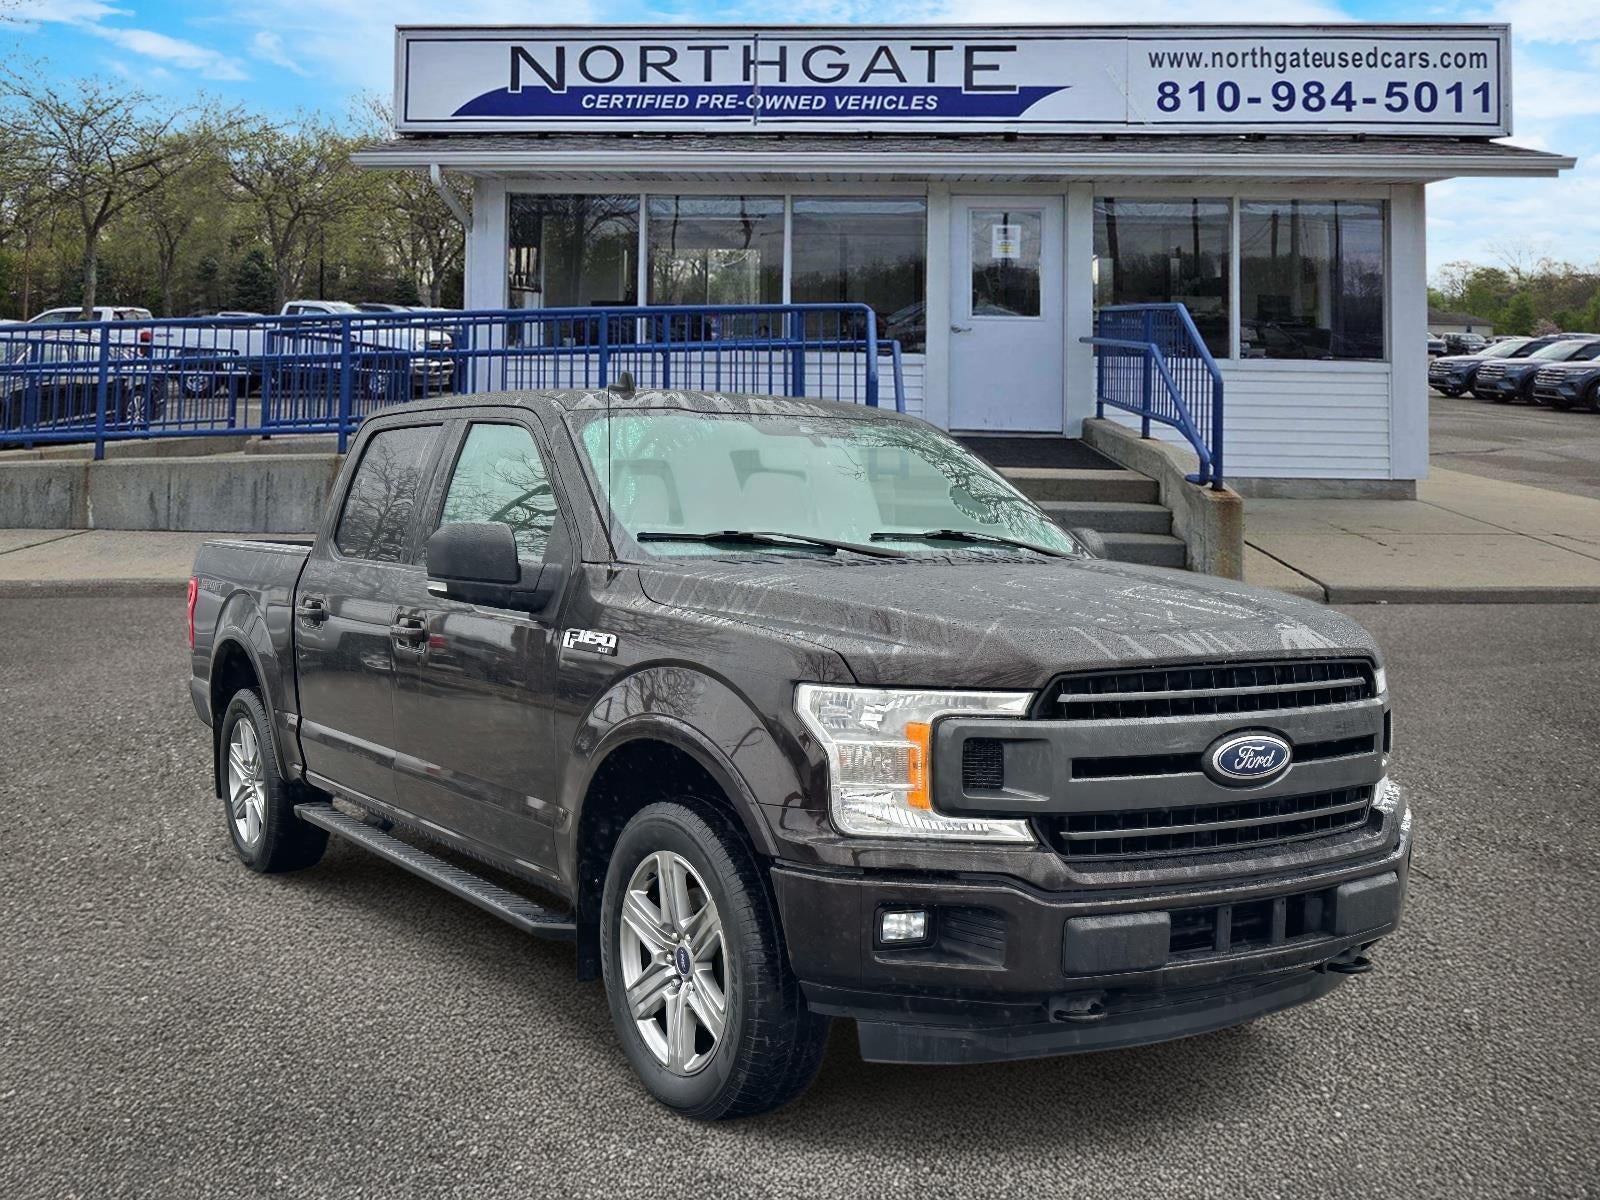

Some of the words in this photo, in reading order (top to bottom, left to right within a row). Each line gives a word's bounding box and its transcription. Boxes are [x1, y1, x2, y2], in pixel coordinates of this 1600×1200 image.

[510, 44, 1017, 92] NORTHGATE
[1148, 46, 1488, 73] www.northgateusedcars.com
[581, 94, 689, 109] CERTIFIED
[695, 94, 827, 110] PRE-OWNED
[834, 95, 939, 110] VEHICLES
[1156, 80, 1491, 113] 810-984-5011
[1234, 745, 1276, 770] Ford
